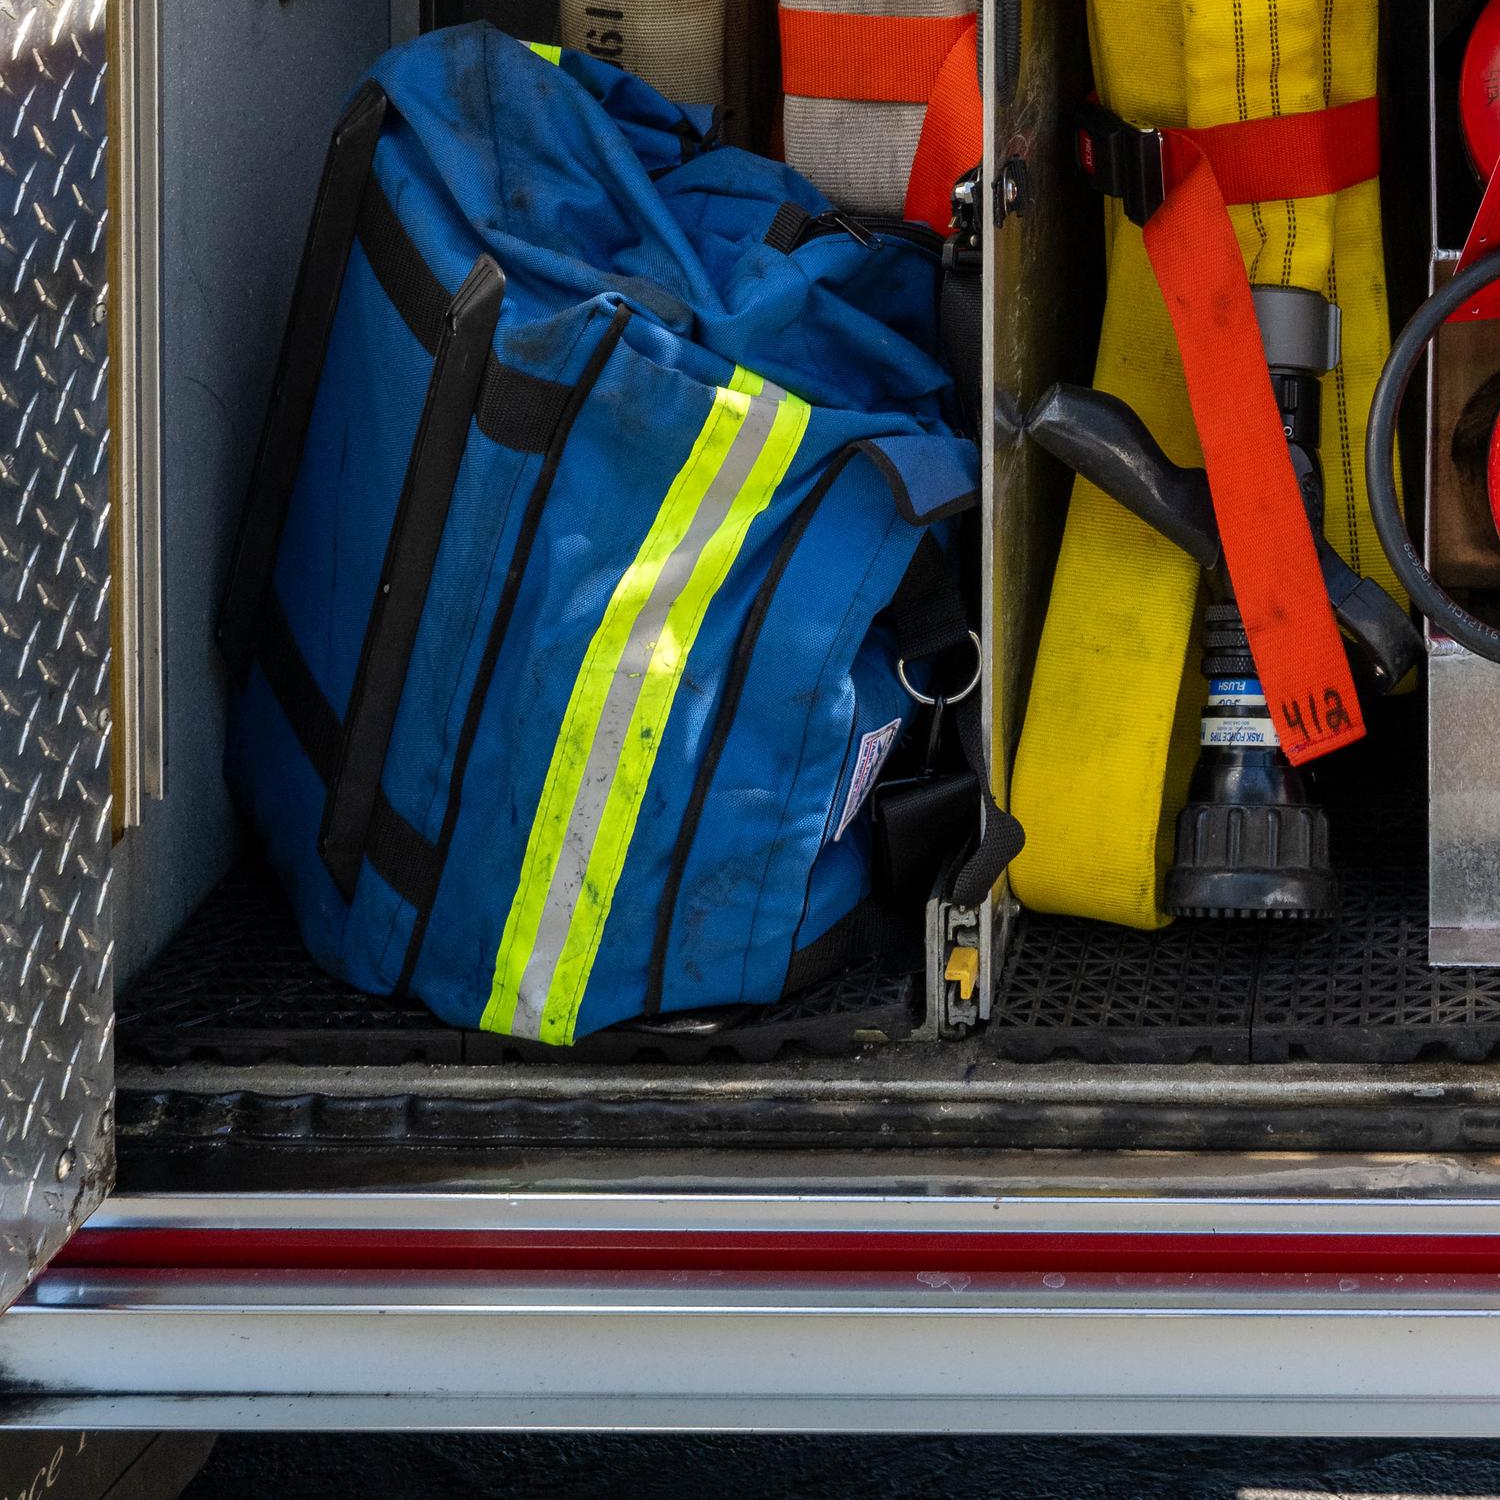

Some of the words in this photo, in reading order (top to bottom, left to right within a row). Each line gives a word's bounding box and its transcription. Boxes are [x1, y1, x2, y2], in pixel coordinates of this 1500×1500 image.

[1218, 681, 1246, 691] FLUSH
[1281, 687, 1352, 743] 412
[1210, 732, 1221, 741] TIPS
[1223, 732, 1245, 742] FORCE
[1246, 732, 1264, 742] TASK
